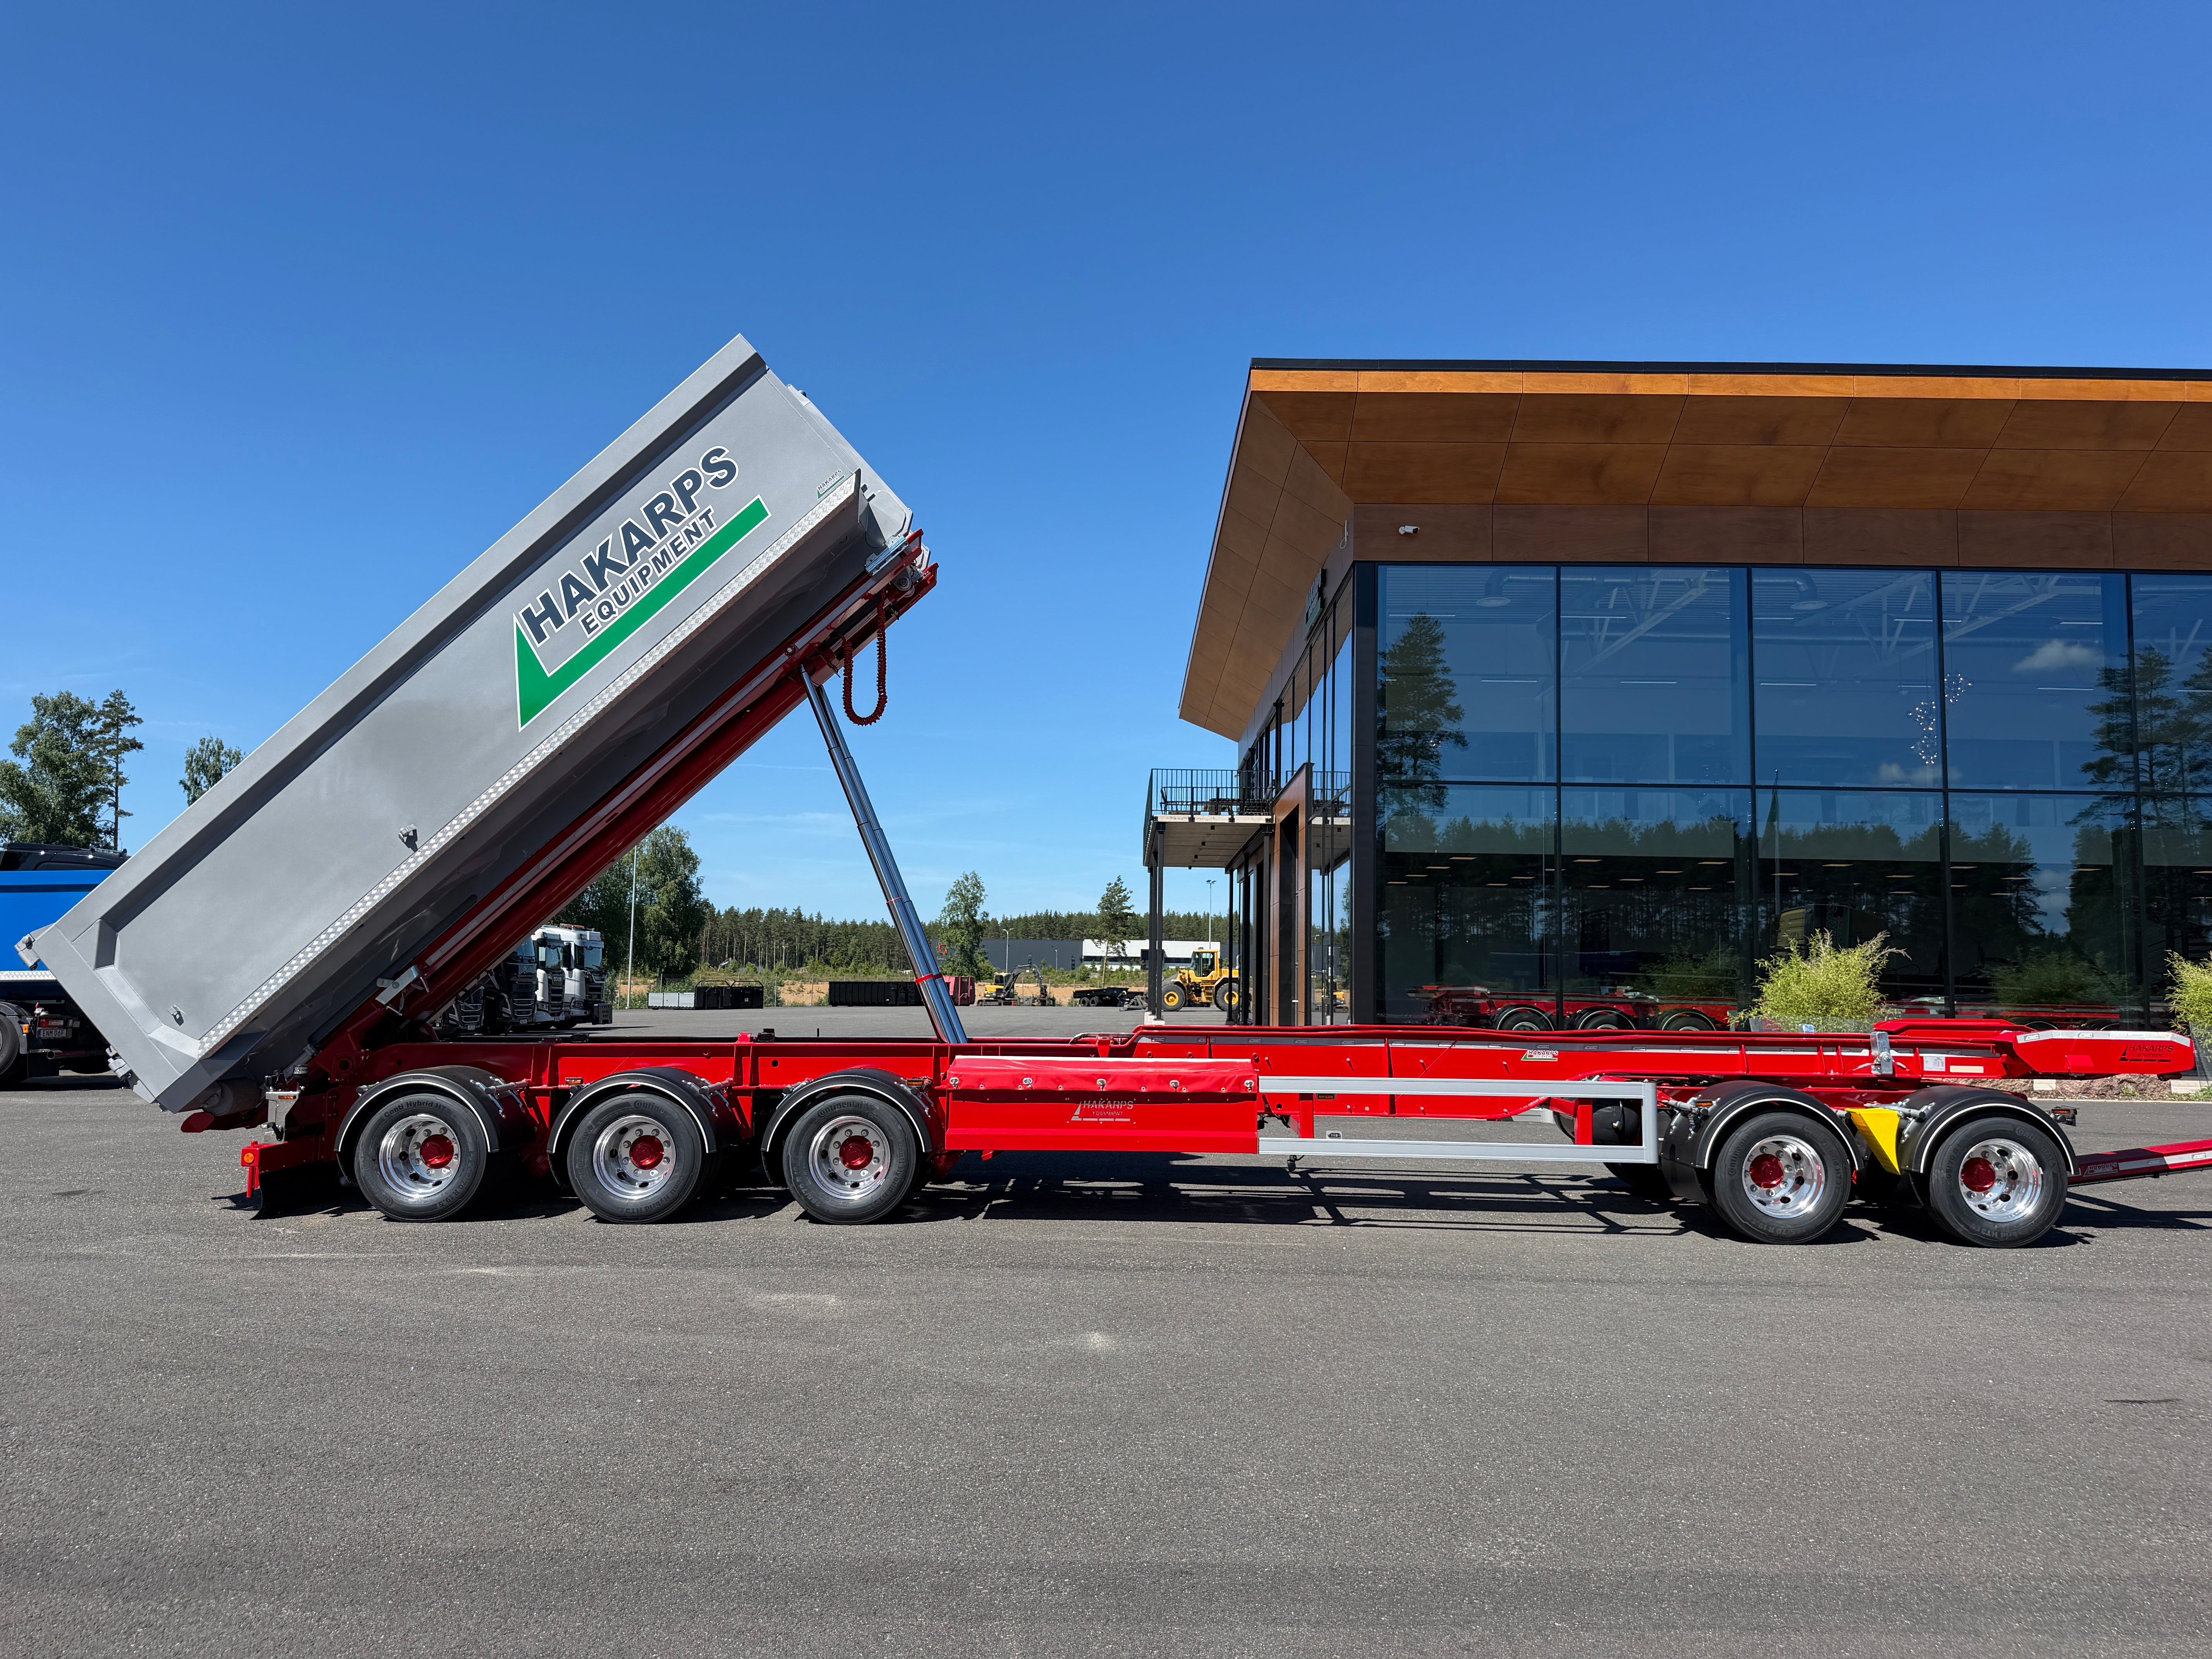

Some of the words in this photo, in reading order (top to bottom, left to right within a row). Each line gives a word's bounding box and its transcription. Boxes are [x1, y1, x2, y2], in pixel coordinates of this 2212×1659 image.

[817, 469, 842, 491] HAKARPS
[521, 447, 738, 646] HAKARPS
[579, 506, 716, 637] EQUIPMENT
[384, 1103, 404, 1117] Conti
[817, 1101, 863, 1118] Continental
[1083, 1101, 1133, 1109] HAKARPS
